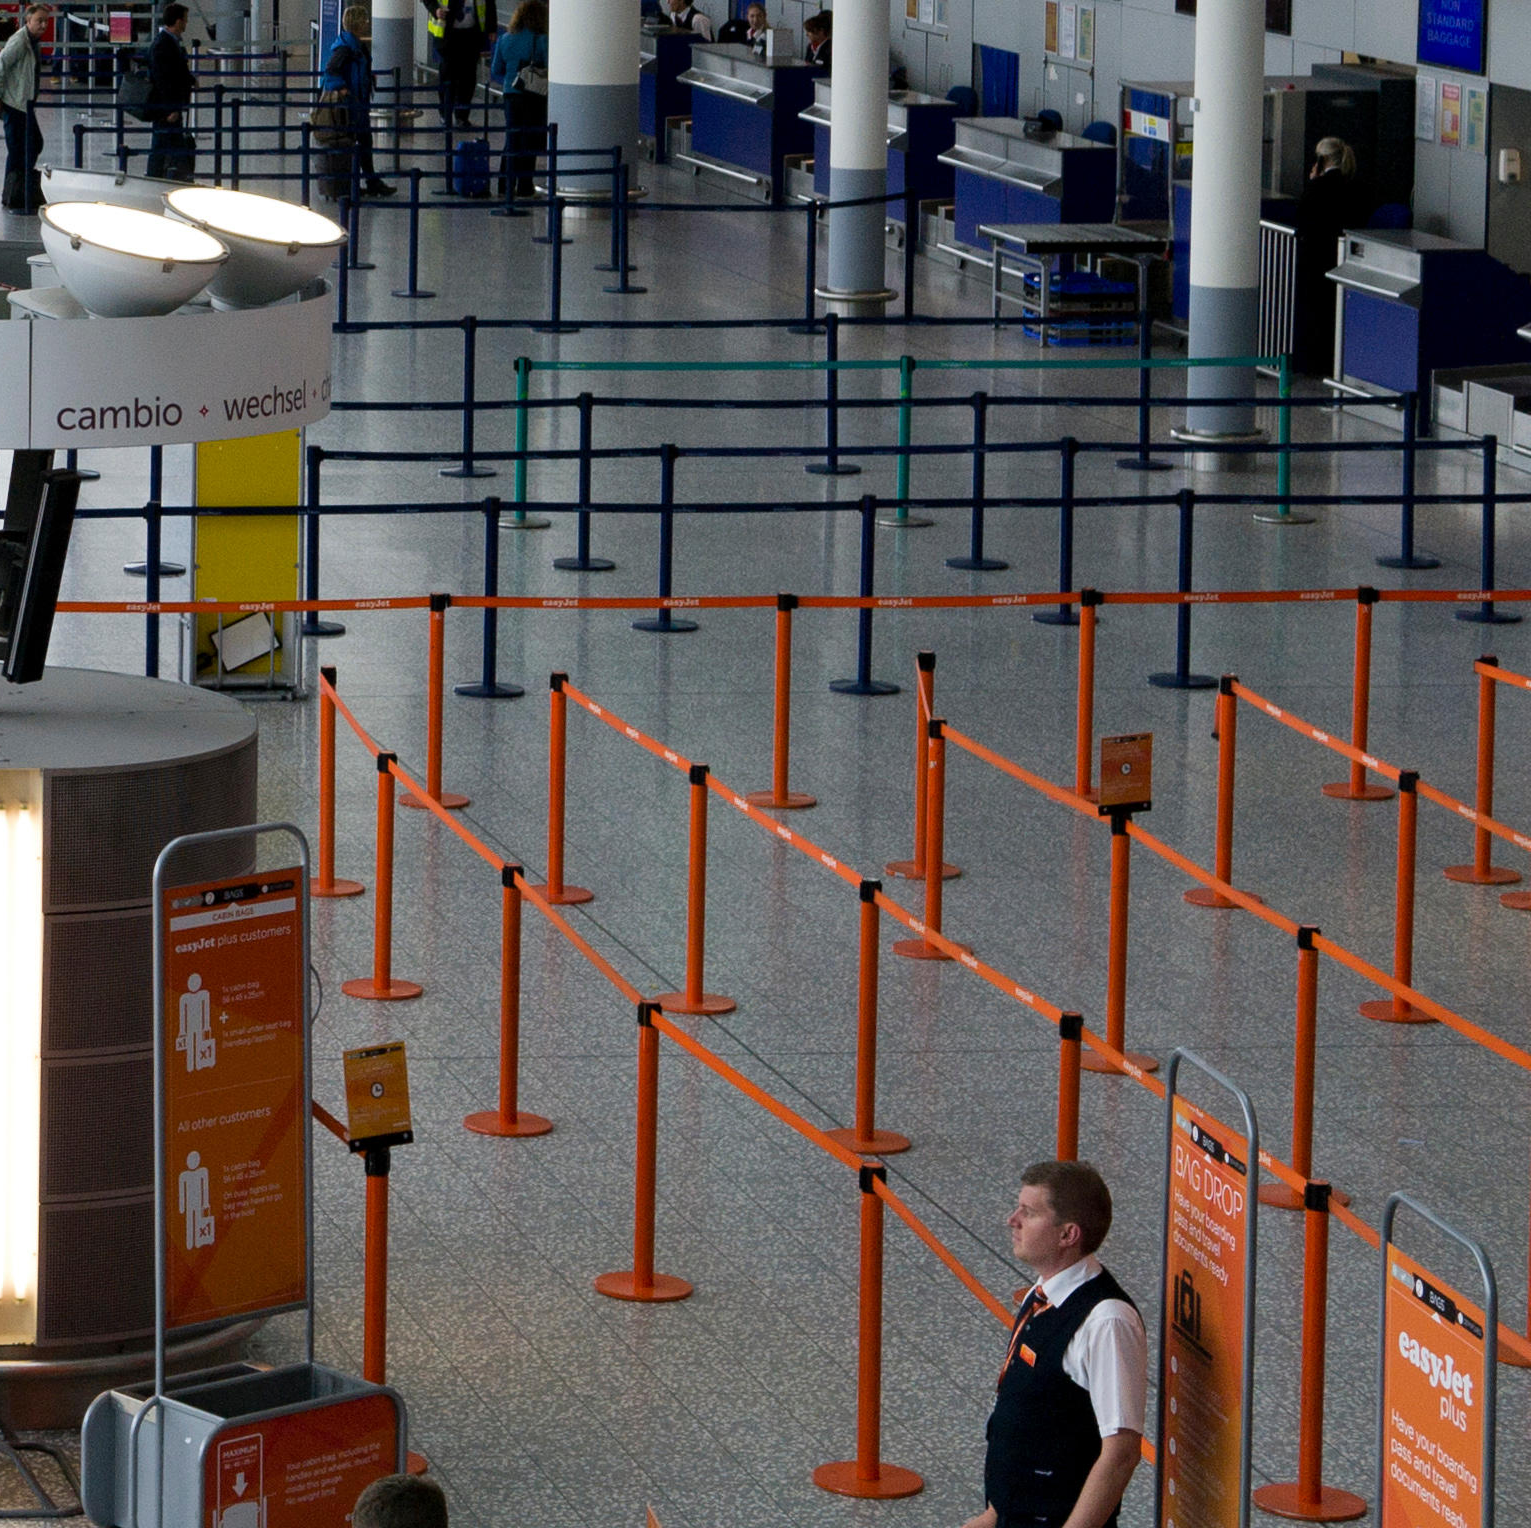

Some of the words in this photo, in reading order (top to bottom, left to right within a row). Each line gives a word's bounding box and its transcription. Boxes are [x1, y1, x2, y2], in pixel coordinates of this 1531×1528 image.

[1426, 12, 1474, 32] STANDARD
[1427, 29, 1471, 49] BAGGAGE
[57, 396, 183, 430] cambio
[223, 380, 307, 422] wechsel
[224, 888, 244, 899] BAGS
[212, 910, 234, 921] CABIN
[235, 907, 254, 918] BAGS
[175, 937, 215, 953] easyJet
[217, 934, 238, 948] plus
[240, 925, 291, 942] customers
[200, 1045, 212, 1060] x1
[177, 1120, 189, 1133] All
[191, 1116, 217, 1131] other
[219, 1107, 271, 1125] customers
[1202, 1135, 1216, 1153] BAGS
[1175, 1144, 1201, 1192] BAG
[1203, 1168, 1243, 1219] DROP
[199, 1223, 211, 1237] x1
[1174, 1187, 1190, 1212] Have
[1190, 1202, 1204, 1224] your
[1205, 1211, 1236, 1251] boarding
[1173, 1210, 1188, 1232] pass
[1189, 1223, 1202, 1242] and
[1202, 1232, 1221, 1257] travel
[1173, 1229, 1209, 1269] documents
[1209, 1261, 1229, 1287] ready
[1429, 1291, 1446, 1312] BAGS
[1399, 1331, 1473, 1406] easyJet
[1440, 1394, 1466, 1432] plus
[223, 1445, 258, 1458] MAXIMUM
[1391, 1407, 1414, 1440] Have
[1415, 1431, 1436, 1456] your
[1437, 1442, 1477, 1494] boarding
[1391, 1438, 1412, 1464] pass
[1413, 1455, 1431, 1479] and
[1432, 1465, 1457, 1501] travel
[1391, 1461, 1440, 1514] documents
